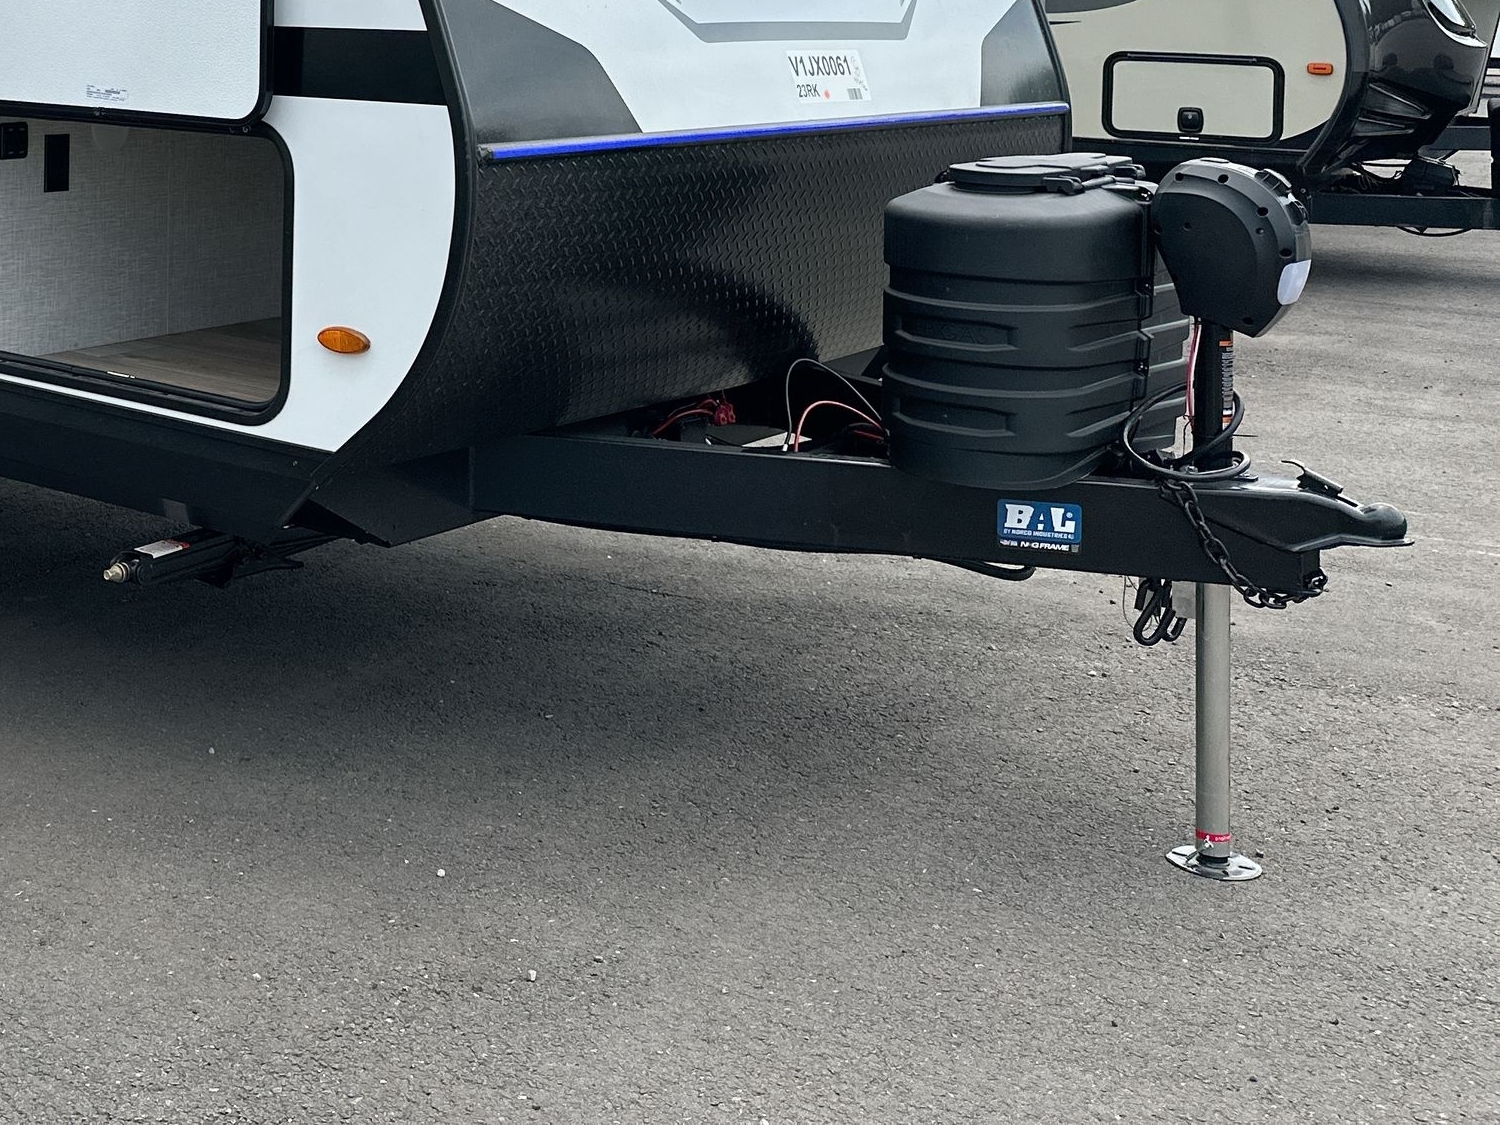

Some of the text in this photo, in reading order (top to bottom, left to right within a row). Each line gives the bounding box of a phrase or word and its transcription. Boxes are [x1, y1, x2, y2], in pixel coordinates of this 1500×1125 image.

[787, 55, 852, 77] V1JX0061
[796, 83, 821, 98] 23RK
[1004, 503, 1076, 534] BAL
[1011, 529, 1032, 537] NORCO
[1032, 530, 1068, 540] INDUSTRIES
